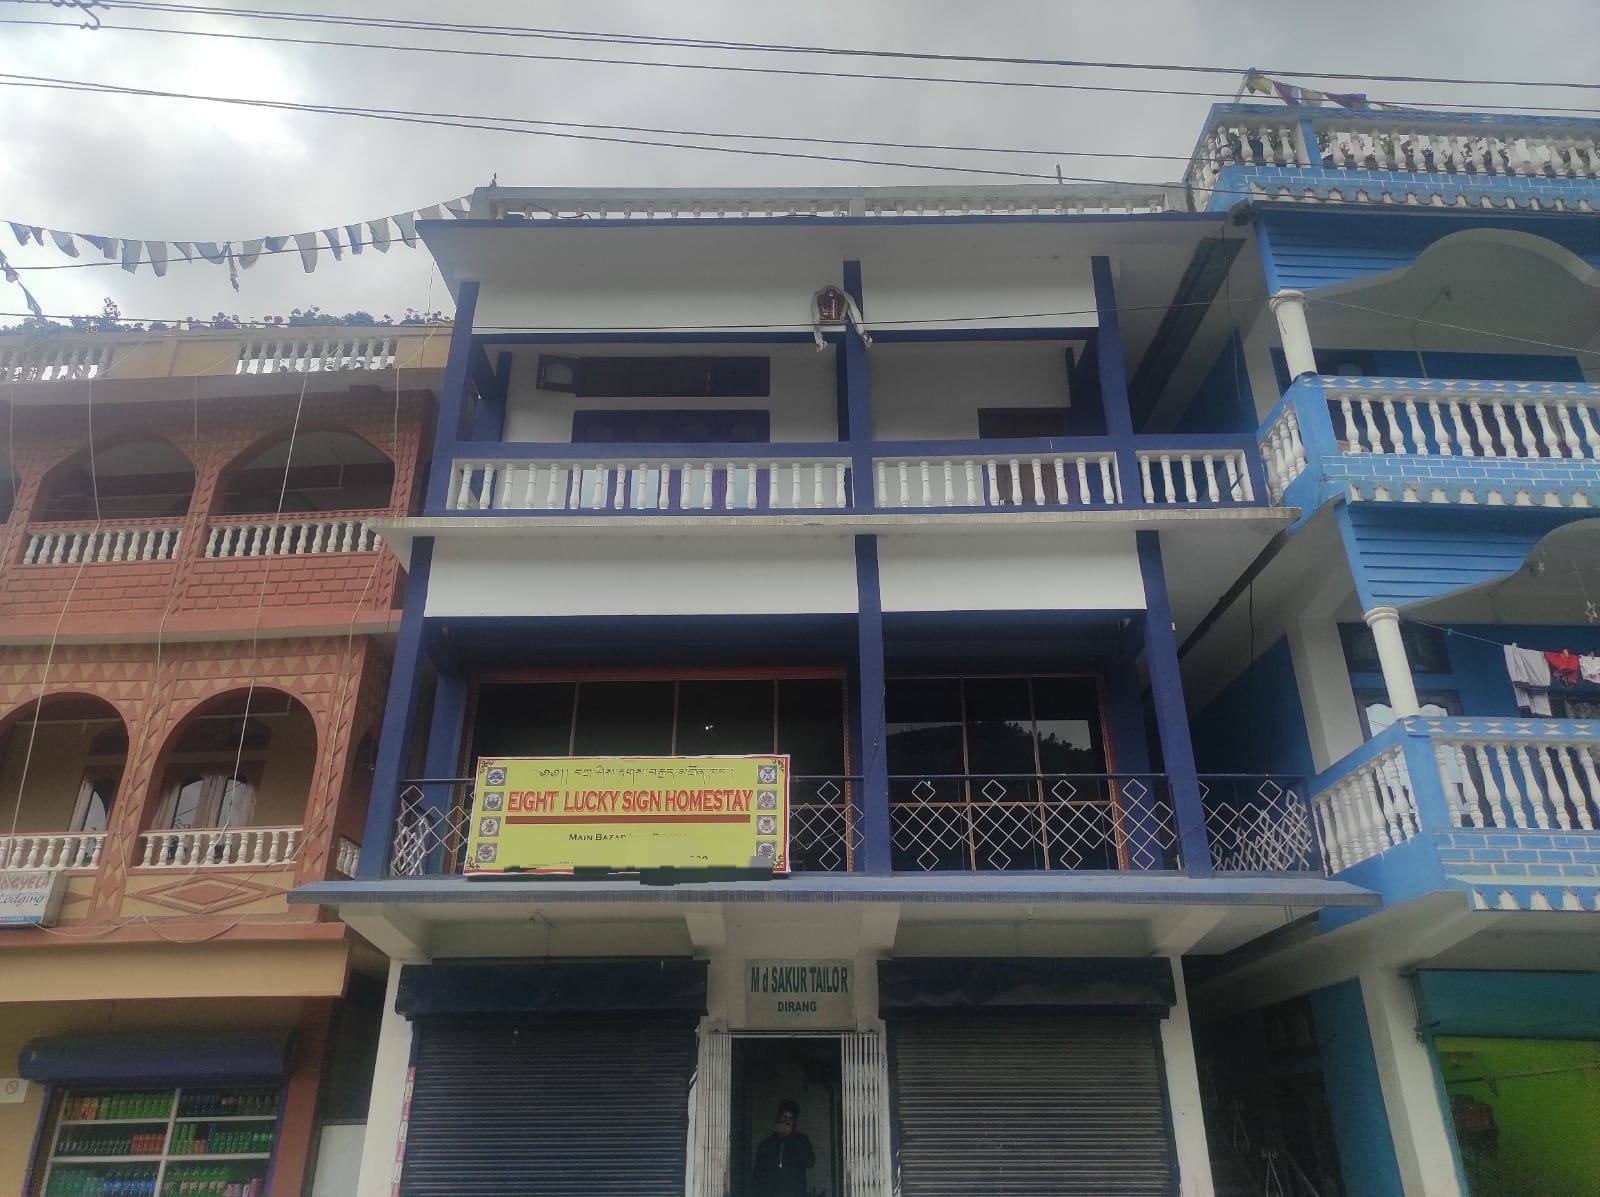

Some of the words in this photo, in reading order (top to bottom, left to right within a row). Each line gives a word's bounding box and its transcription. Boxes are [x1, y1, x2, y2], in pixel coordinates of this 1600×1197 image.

[507, 790, 559, 813] EIGHT
[563, 790, 620, 813] LUCKY
[621, 789, 662, 812] SIGN
[665, 788, 754, 812] HOMESTAY
[771, 966, 807, 993] SAKUR
[809, 966, 848, 993] TAILOR
[777, 1001, 817, 1012] DIRANG
